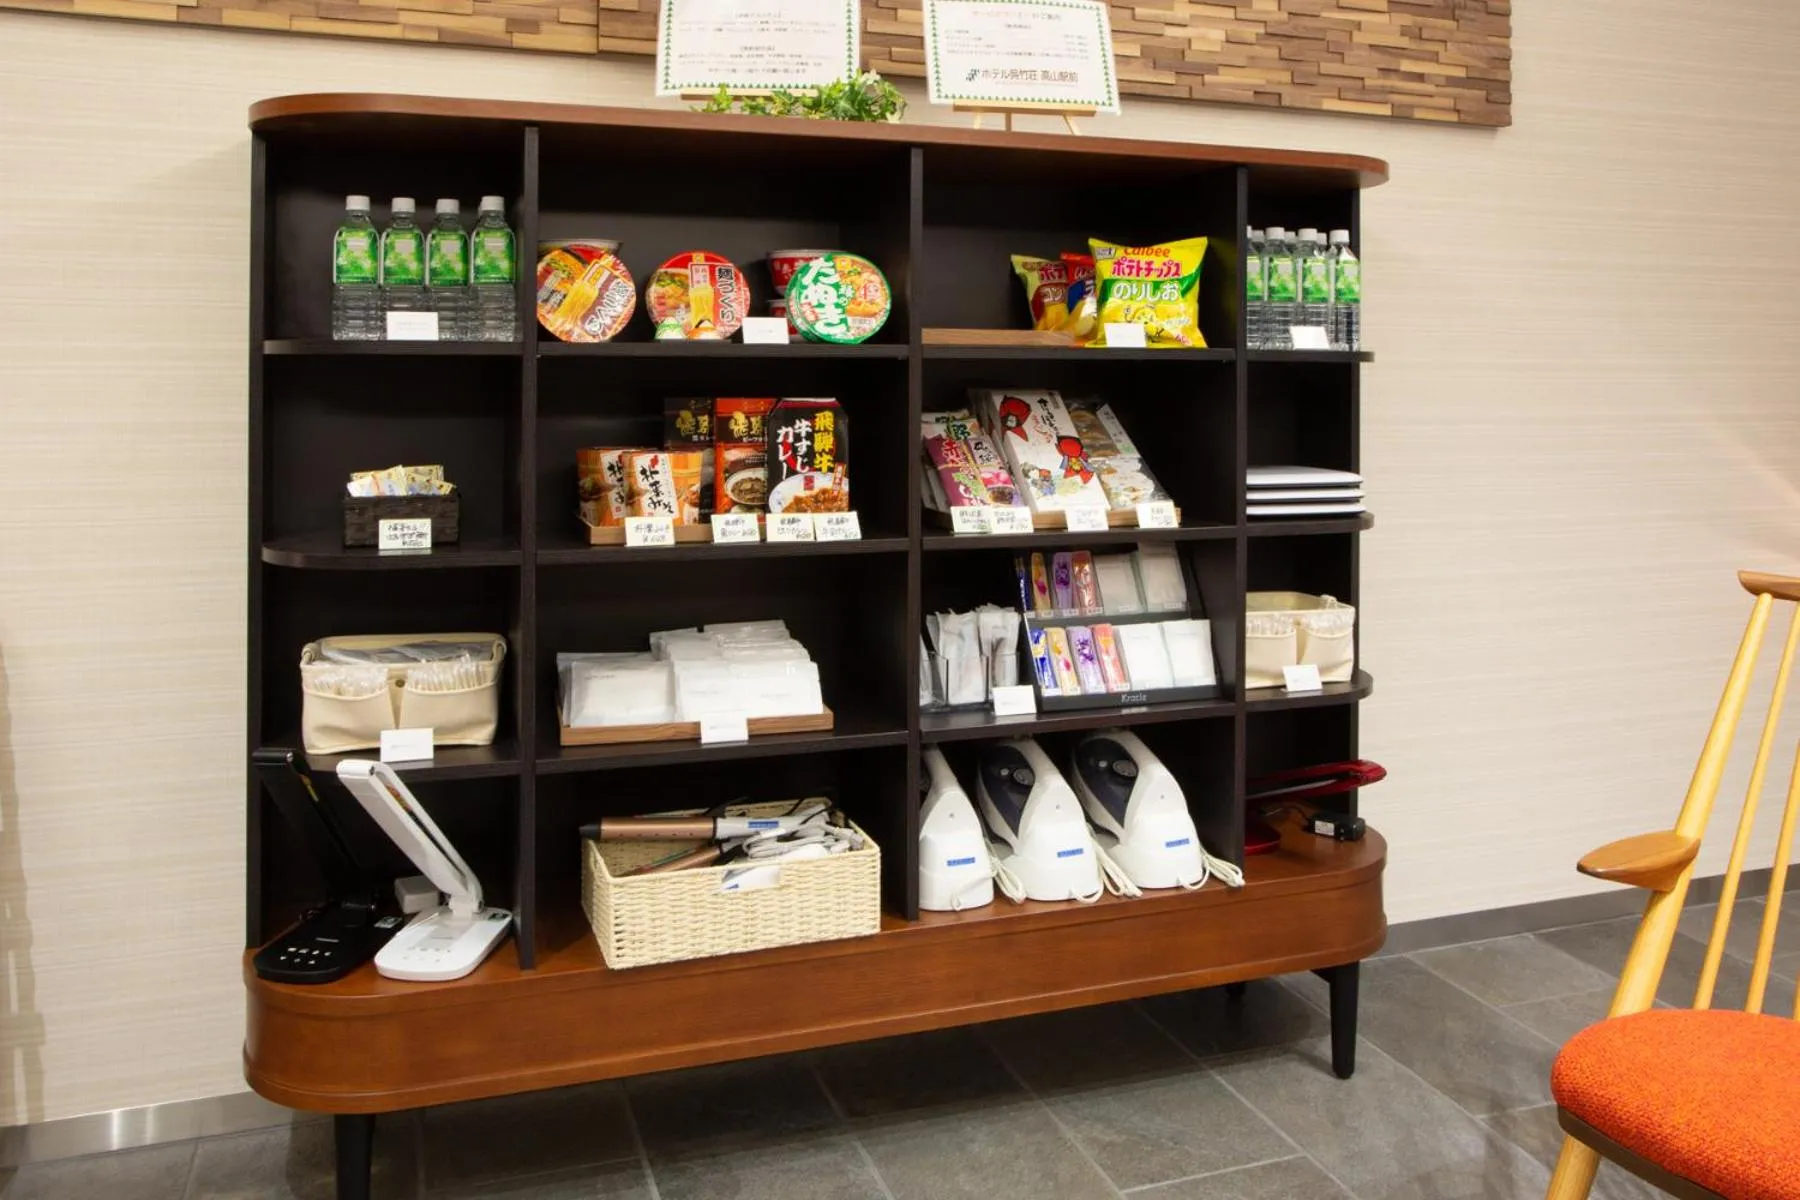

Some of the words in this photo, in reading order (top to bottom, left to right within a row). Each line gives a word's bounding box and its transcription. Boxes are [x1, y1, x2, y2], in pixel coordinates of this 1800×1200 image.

[981, 68, 1037, 81] ホテル呉竹荘
[1041, 69, 1079, 83] 高山駅前
[1112, 256, 1182, 277] ポテトチップス
[1113, 281, 1180, 301] のりしお
[776, 426, 795, 481] カレー
[794, 418, 812, 472] 牛すじ
[814, 410, 835, 473] 飛騨牛
[639, 463, 675, 513] 朴葉みそ
